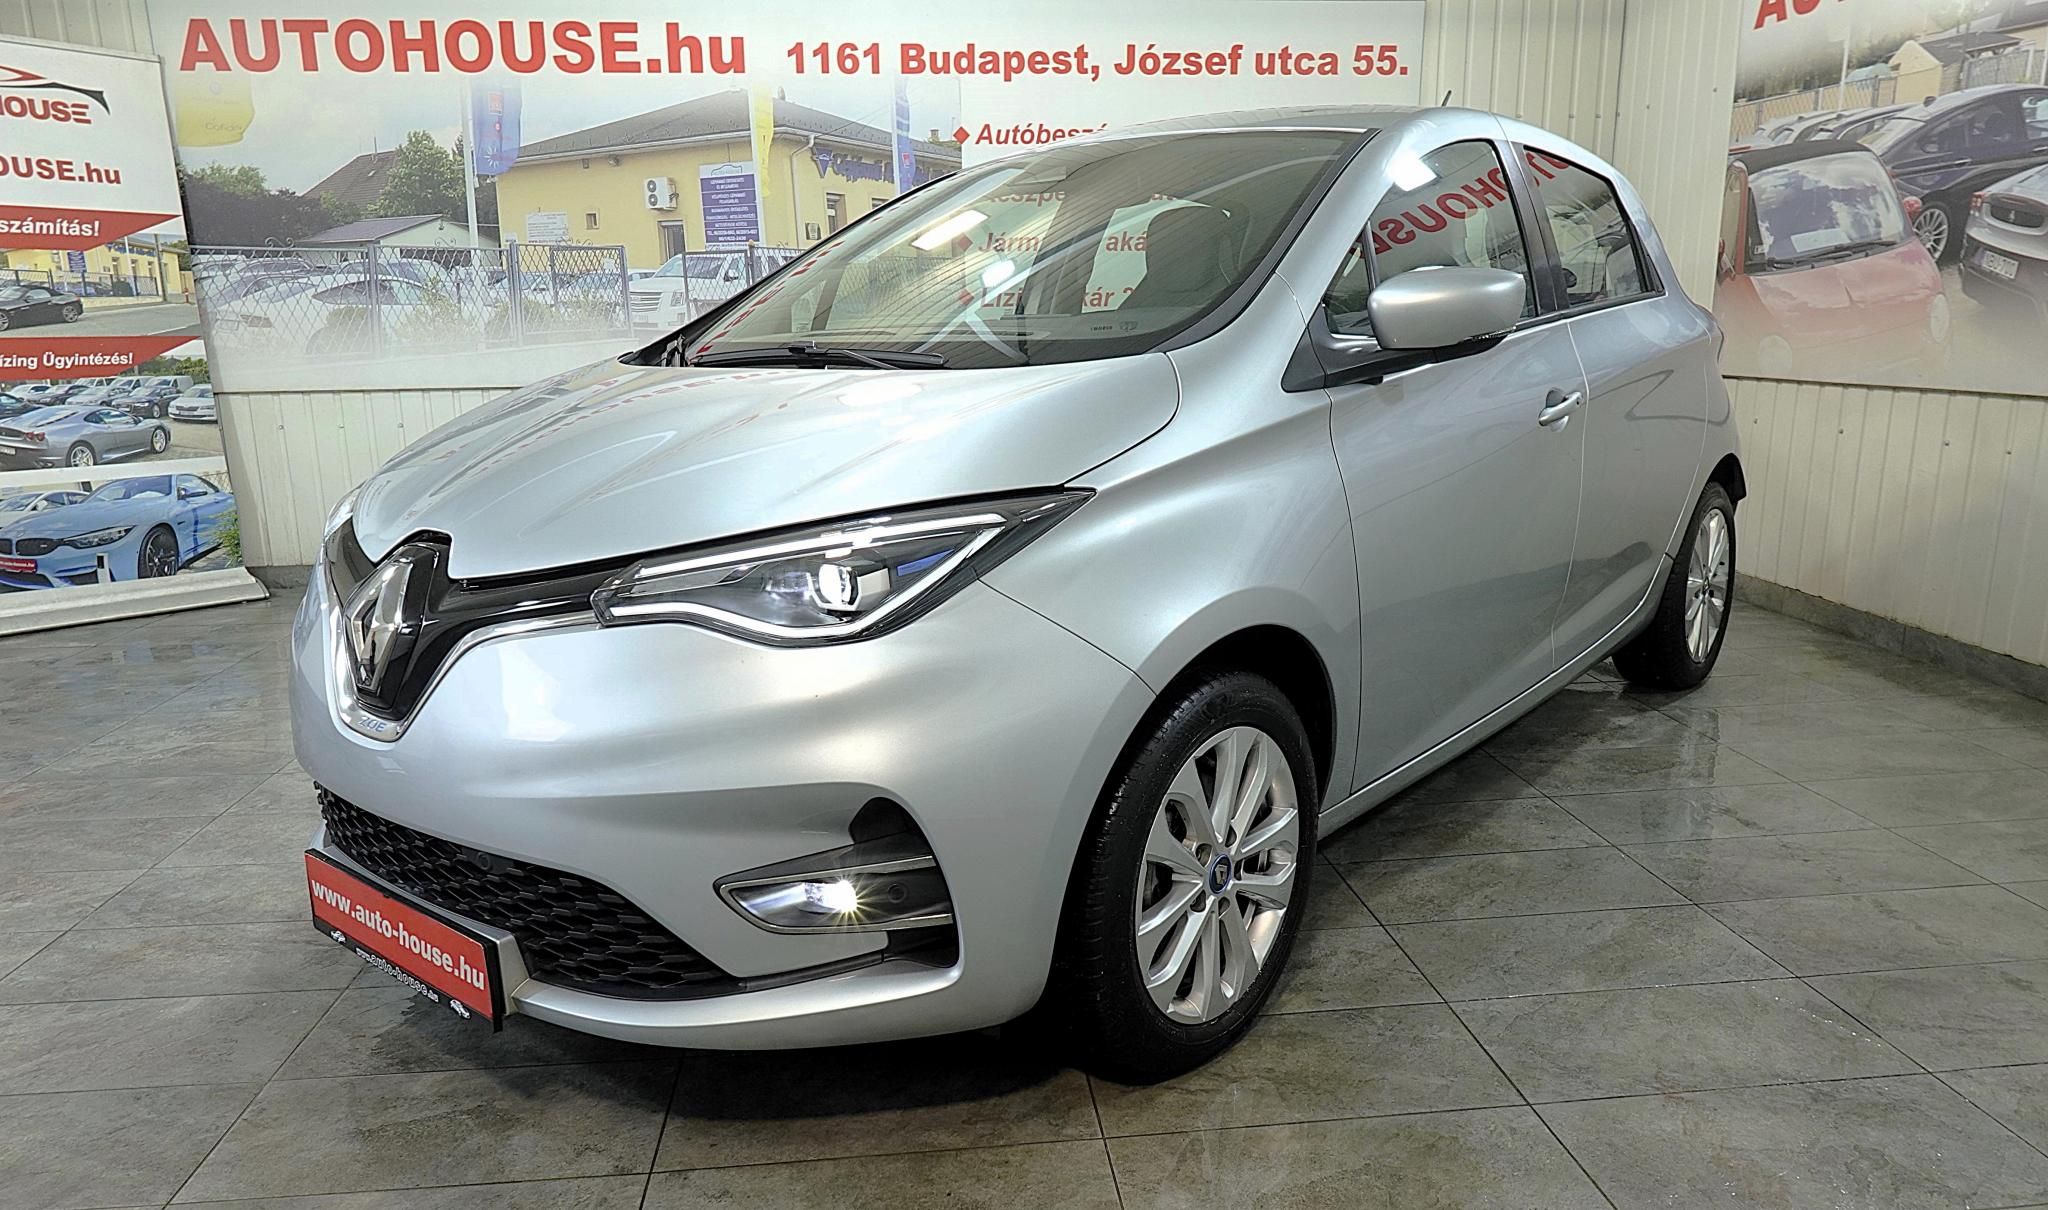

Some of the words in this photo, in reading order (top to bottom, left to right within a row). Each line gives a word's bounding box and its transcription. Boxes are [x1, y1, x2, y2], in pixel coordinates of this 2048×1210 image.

[179, 18, 746, 74] AUTOHOUSE.hu
[787, 42, 880, 74] 1161
[900, 43, 1100, 82] Budapest,
[1114, 44, 1243, 75] József
[1255, 46, 1338, 75] utca
[1352, 45, 1408, 75] 55.
[0, 95, 92, 124] OUSE
[977, 232, 1039, 252] Járm
[1106, 231, 1147, 252] aká
[42, 351, 134, 369] Ügyintézés!
[359, 716, 387, 732] ZOE
[311, 879, 485, 990] www.auto-house.hu
